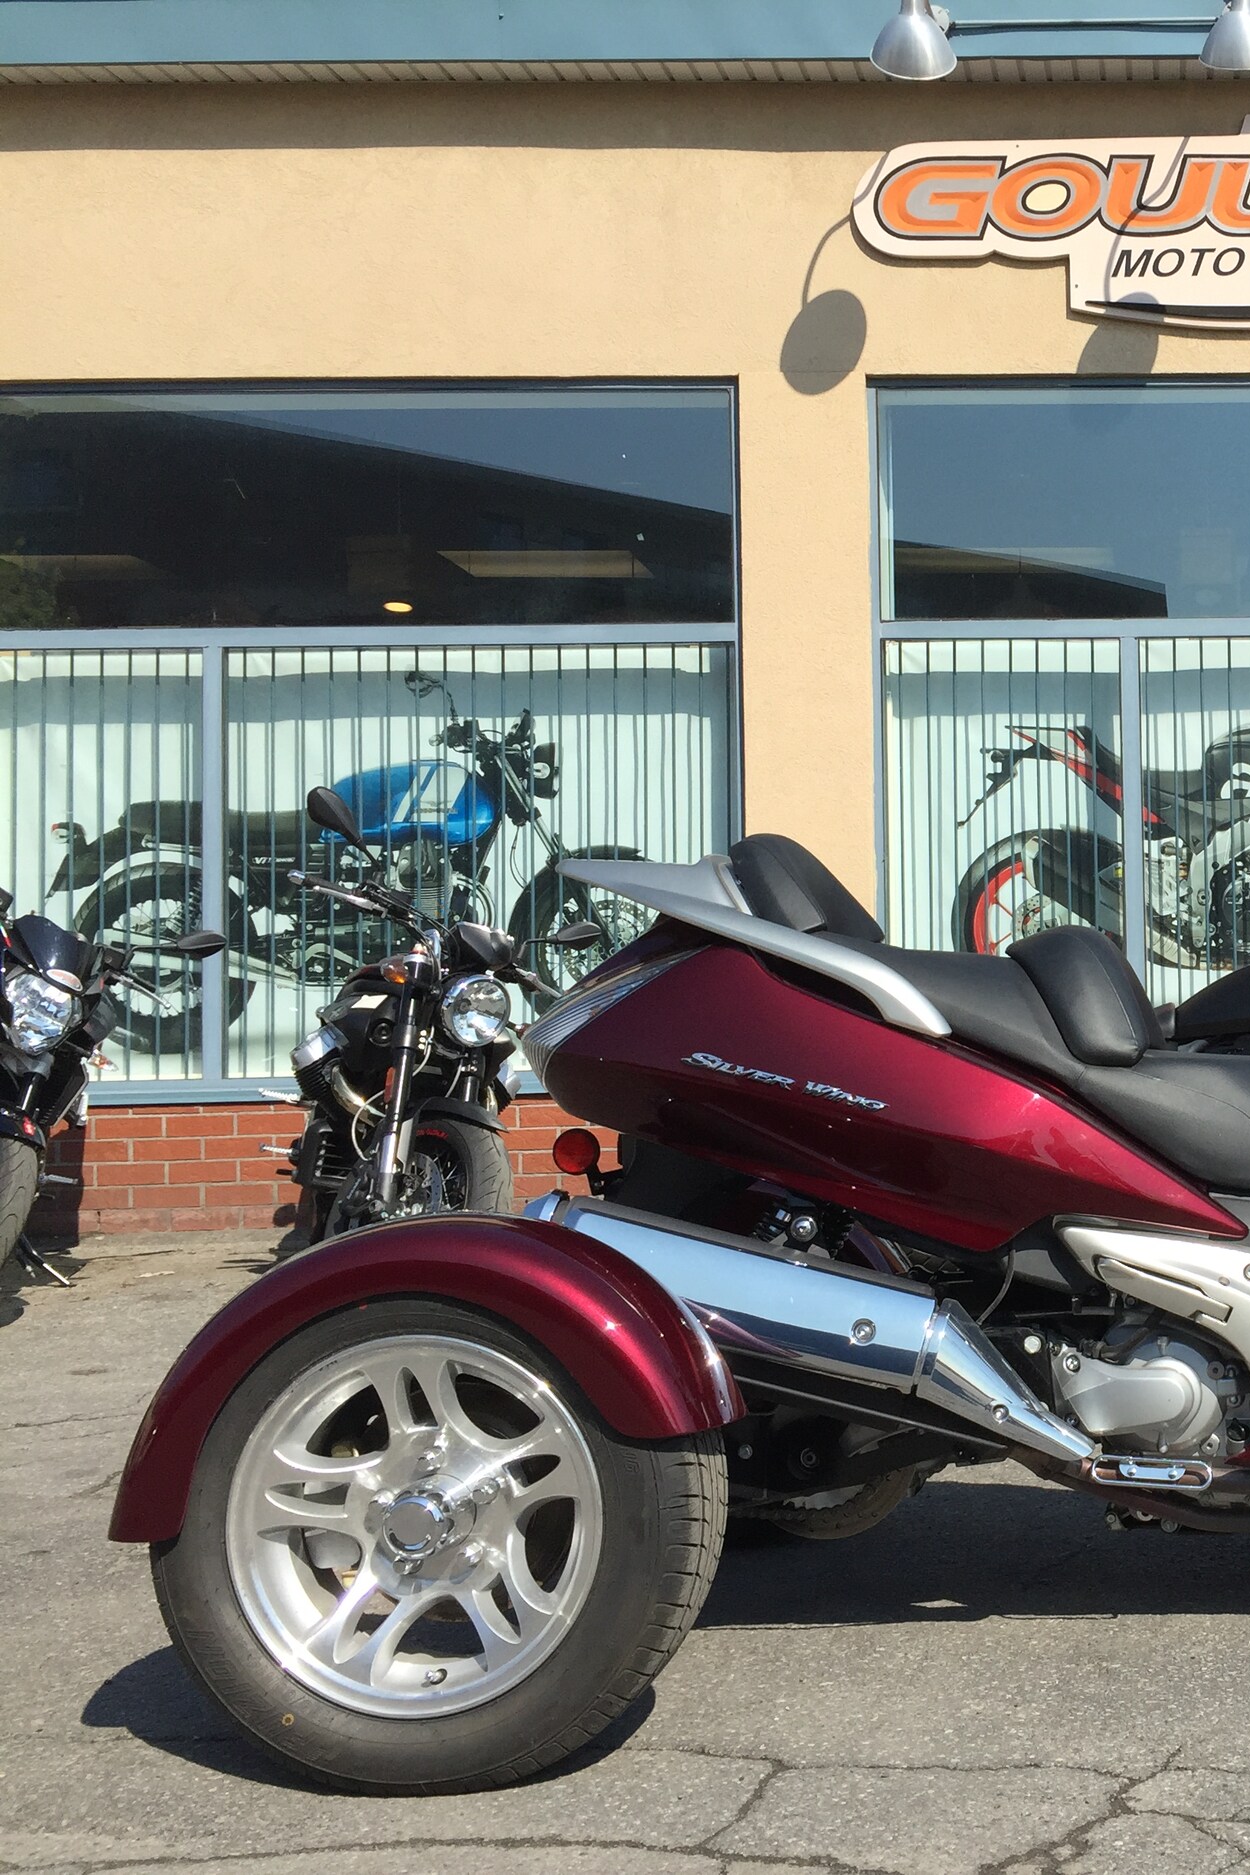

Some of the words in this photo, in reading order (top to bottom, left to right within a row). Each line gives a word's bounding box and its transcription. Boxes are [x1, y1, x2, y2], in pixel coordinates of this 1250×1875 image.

[1111, 247, 1246, 277] MOTO
[681, 1052, 797, 1090] SILVER
[802, 1080, 890, 1111] WING
